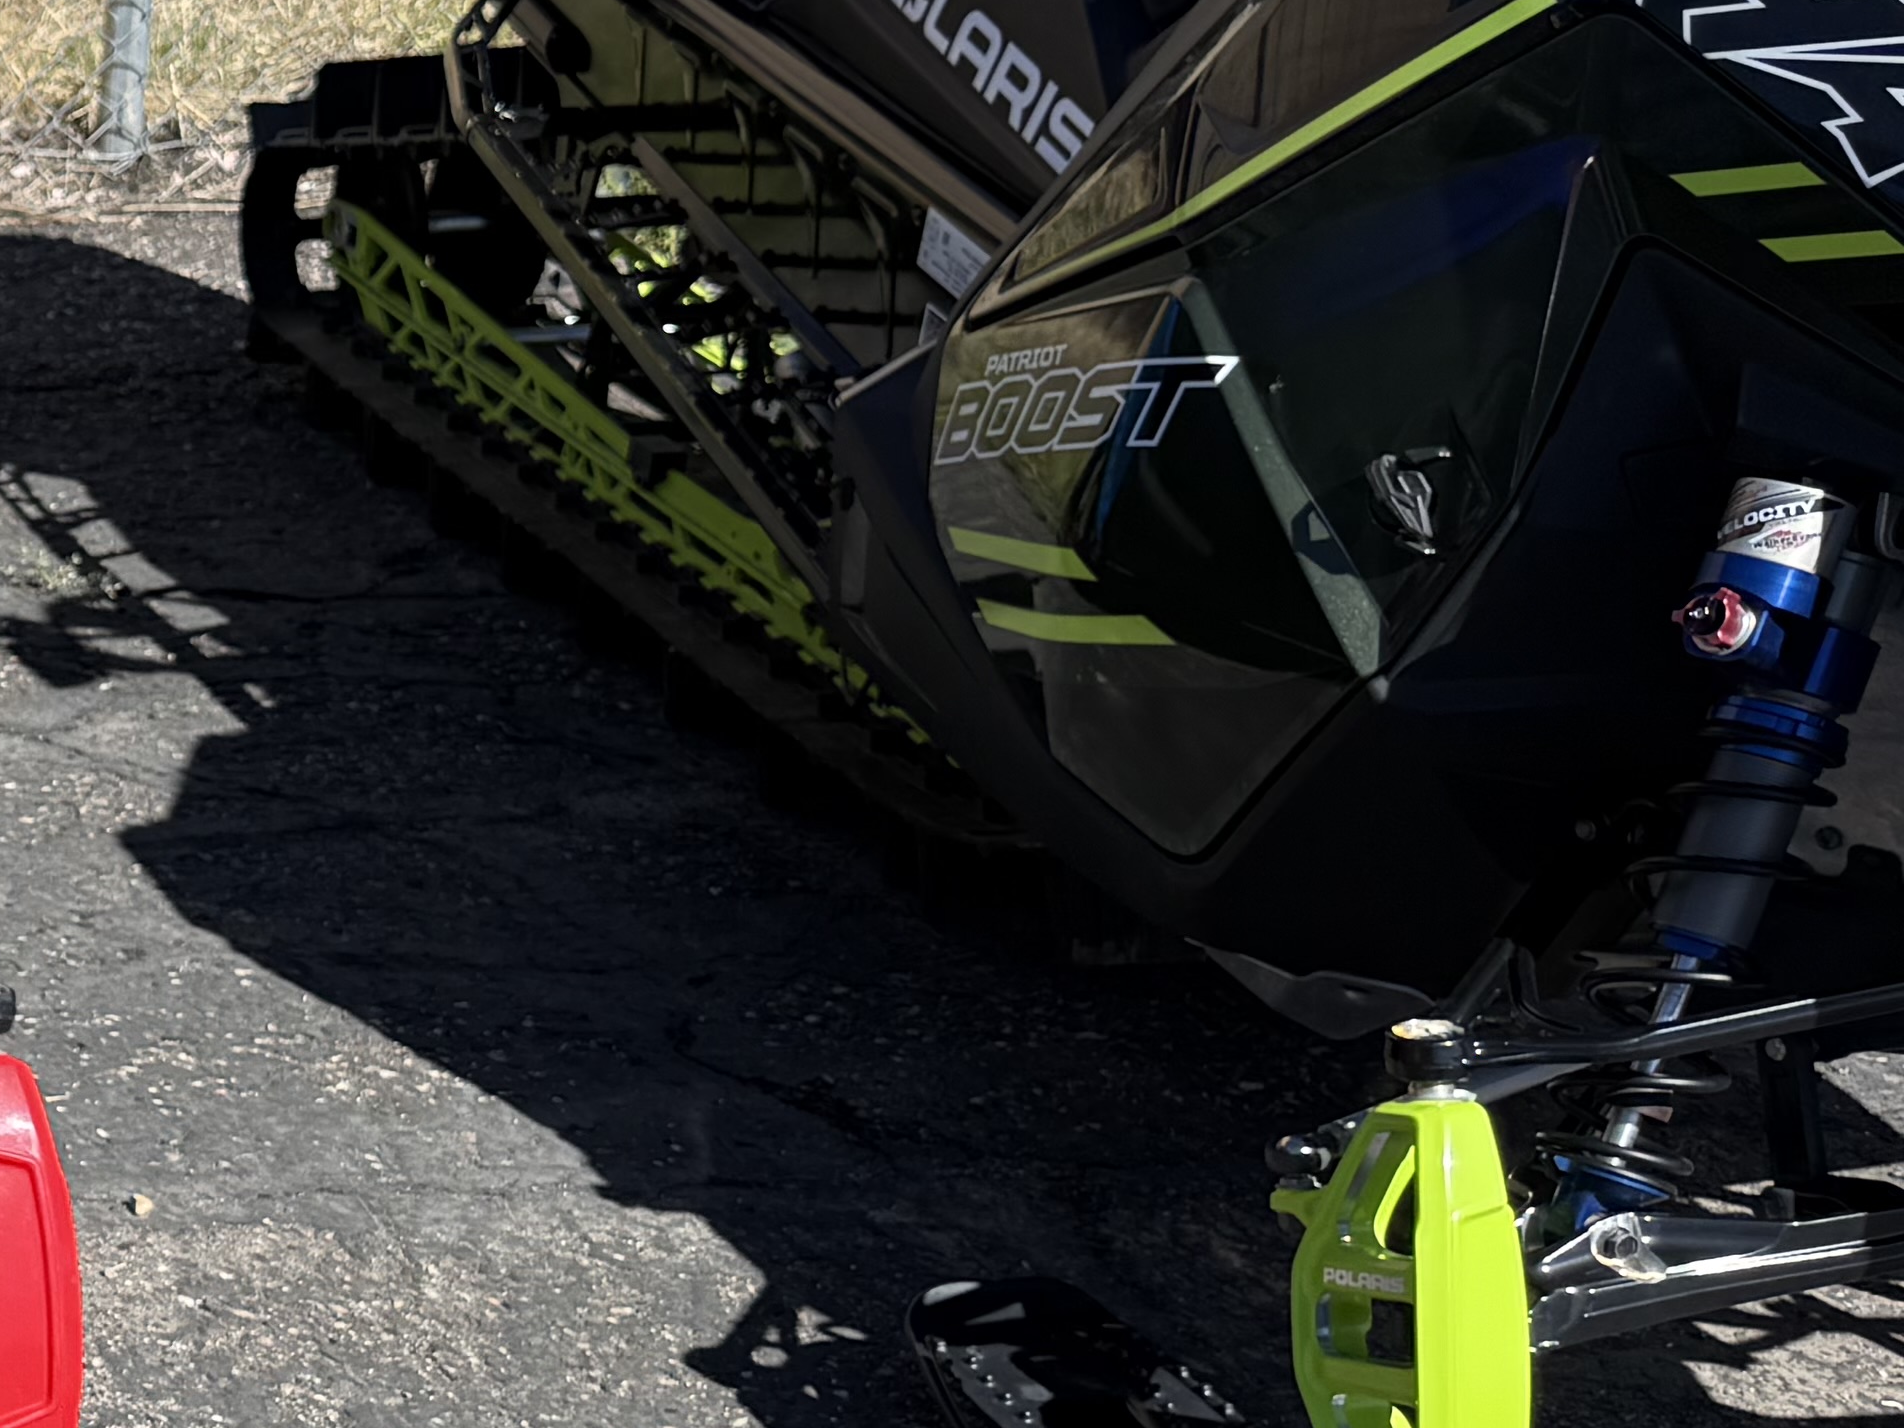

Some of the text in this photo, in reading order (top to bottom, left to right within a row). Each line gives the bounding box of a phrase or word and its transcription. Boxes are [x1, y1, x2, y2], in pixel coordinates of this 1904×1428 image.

[984, 343, 1068, 376] PATRIOT
[933, 354, 1241, 466] BOOST
[1322, 1266, 1406, 1293] POLARIS
